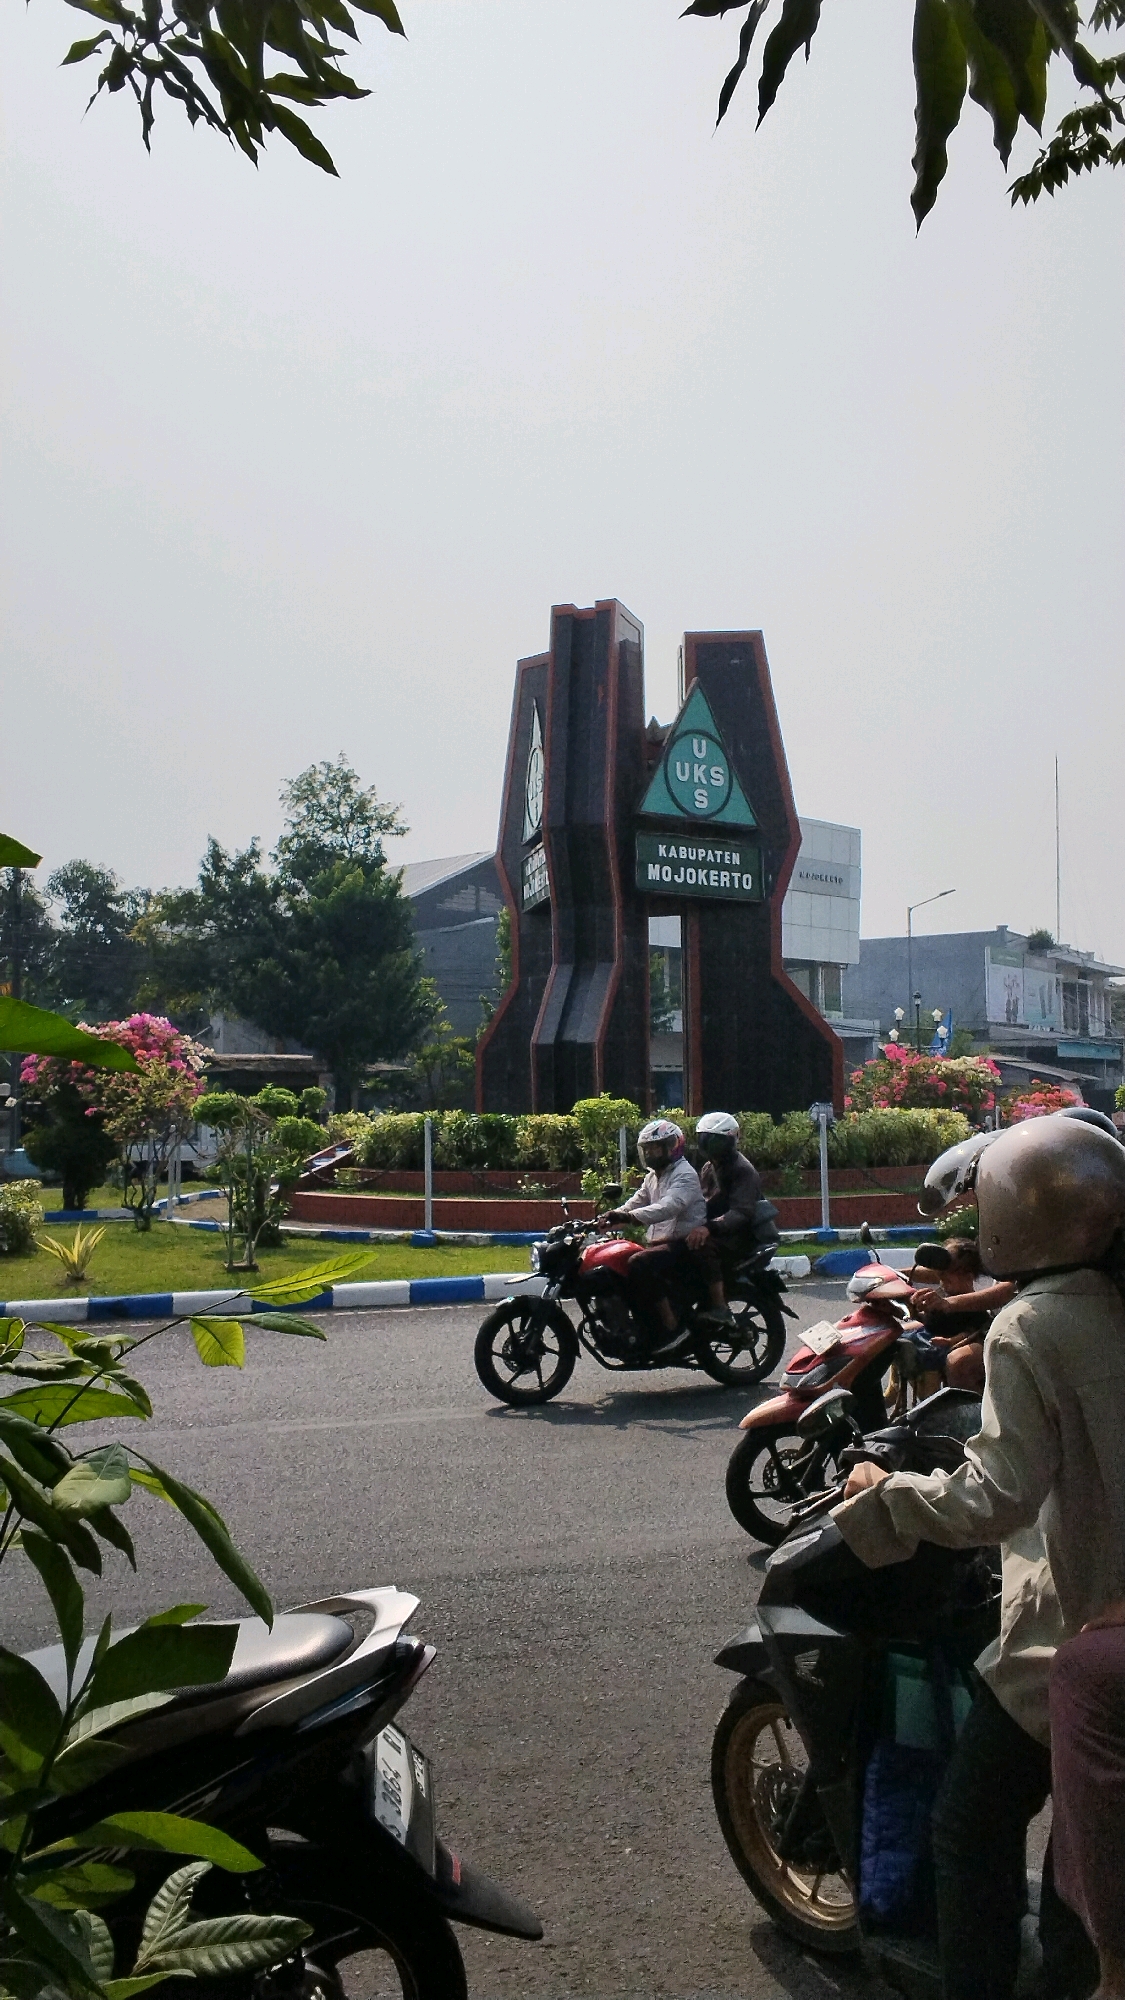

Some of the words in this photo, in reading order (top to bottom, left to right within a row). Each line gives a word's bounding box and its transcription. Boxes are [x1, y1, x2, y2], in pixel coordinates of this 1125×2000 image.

[692, 738, 706, 759] U
[676, 762, 725, 787] UKS
[694, 789, 708, 809] S
[658, 844, 740, 865] KABUPATEN
[648, 864, 752, 890] MOJOKERTO
[381, 1757, 402, 1816] 3864
[380, 1814, 401, 1838] S
